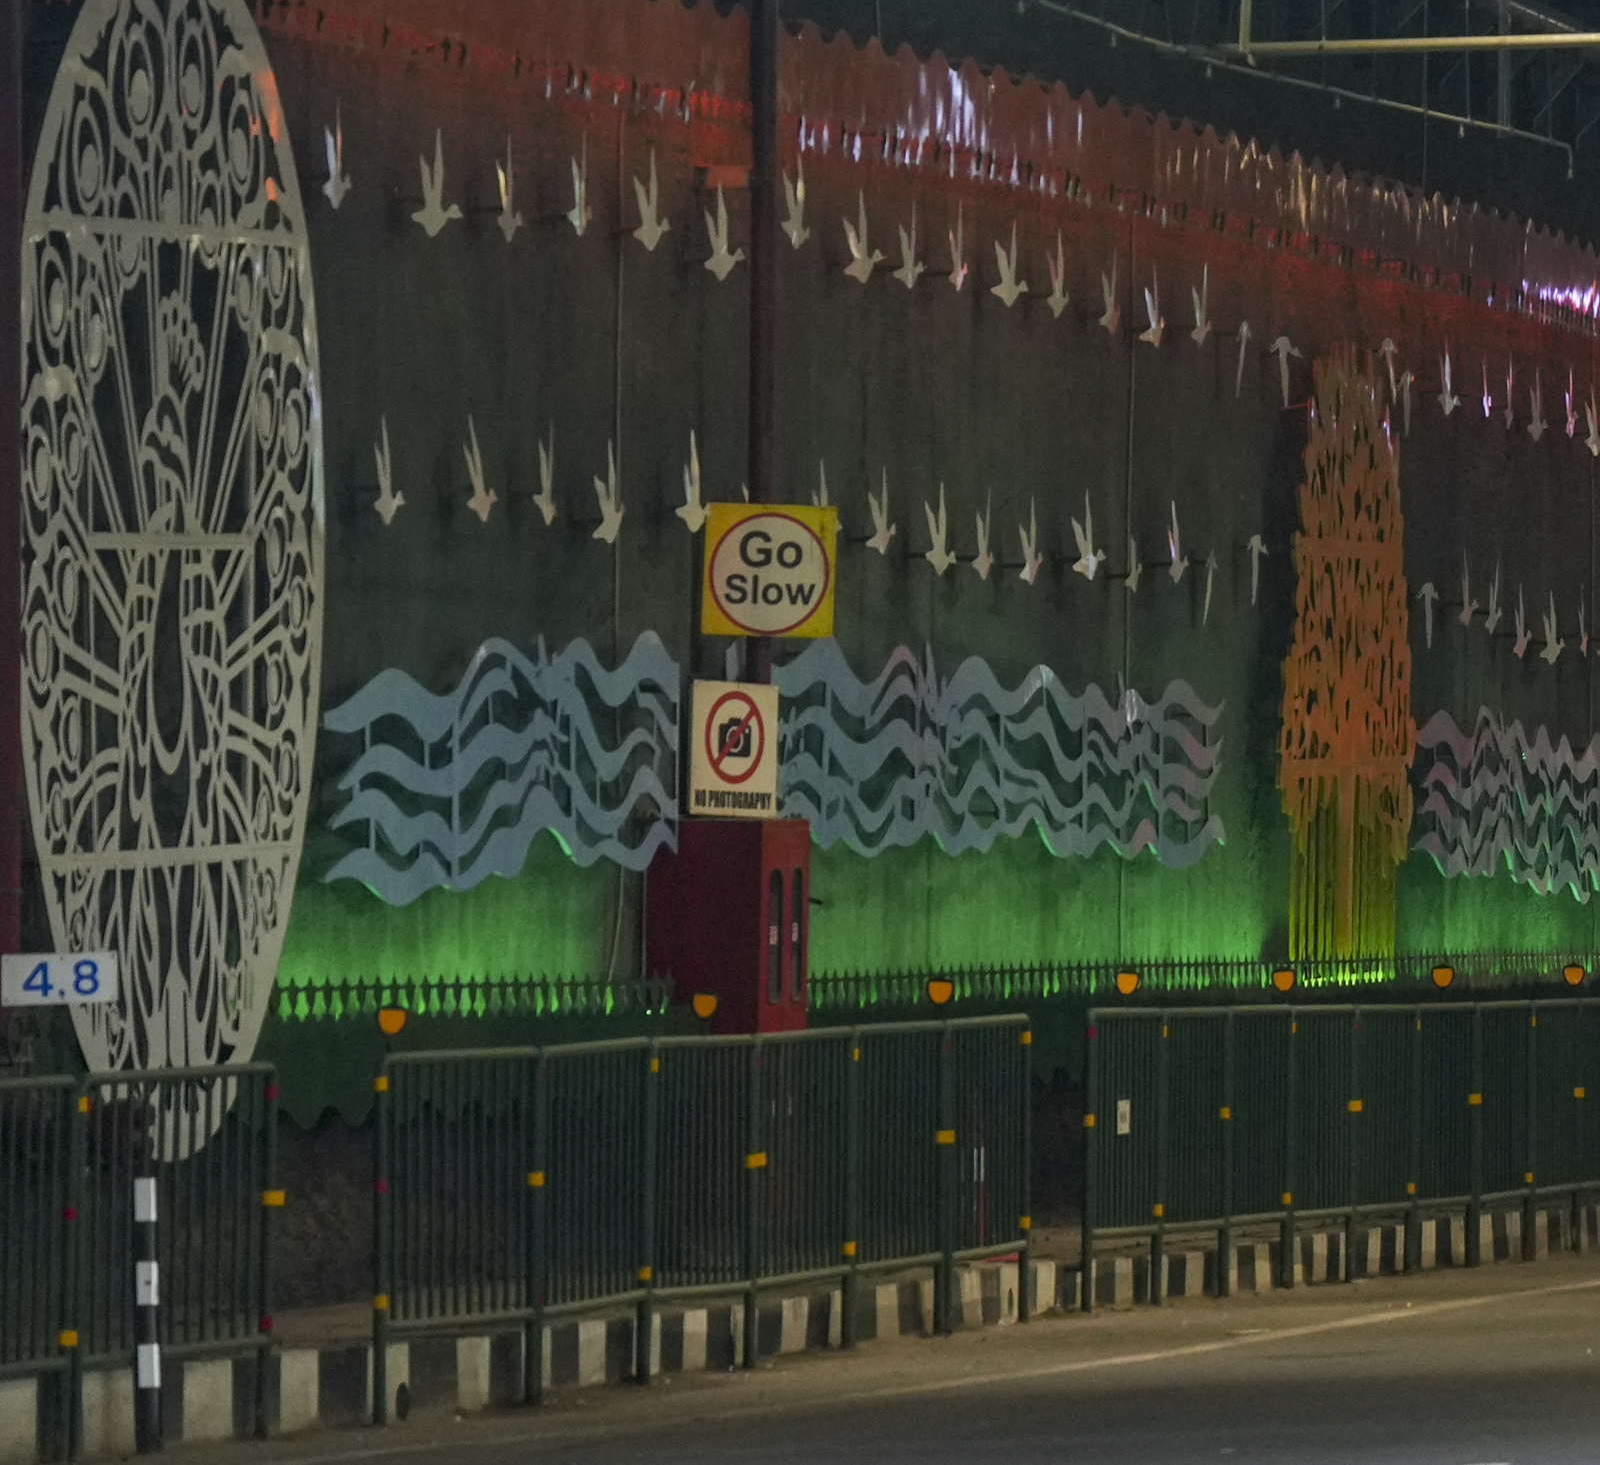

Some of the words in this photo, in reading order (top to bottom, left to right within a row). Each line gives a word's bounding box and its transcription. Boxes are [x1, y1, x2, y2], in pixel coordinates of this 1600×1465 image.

[740, 531, 803, 569] Go
[724, 574, 816, 605] Slow
[695, 789, 706, 808] NO
[708, 790, 771, 810] PHOTOGRAPHY
[22, 960, 99, 998] 4.8
